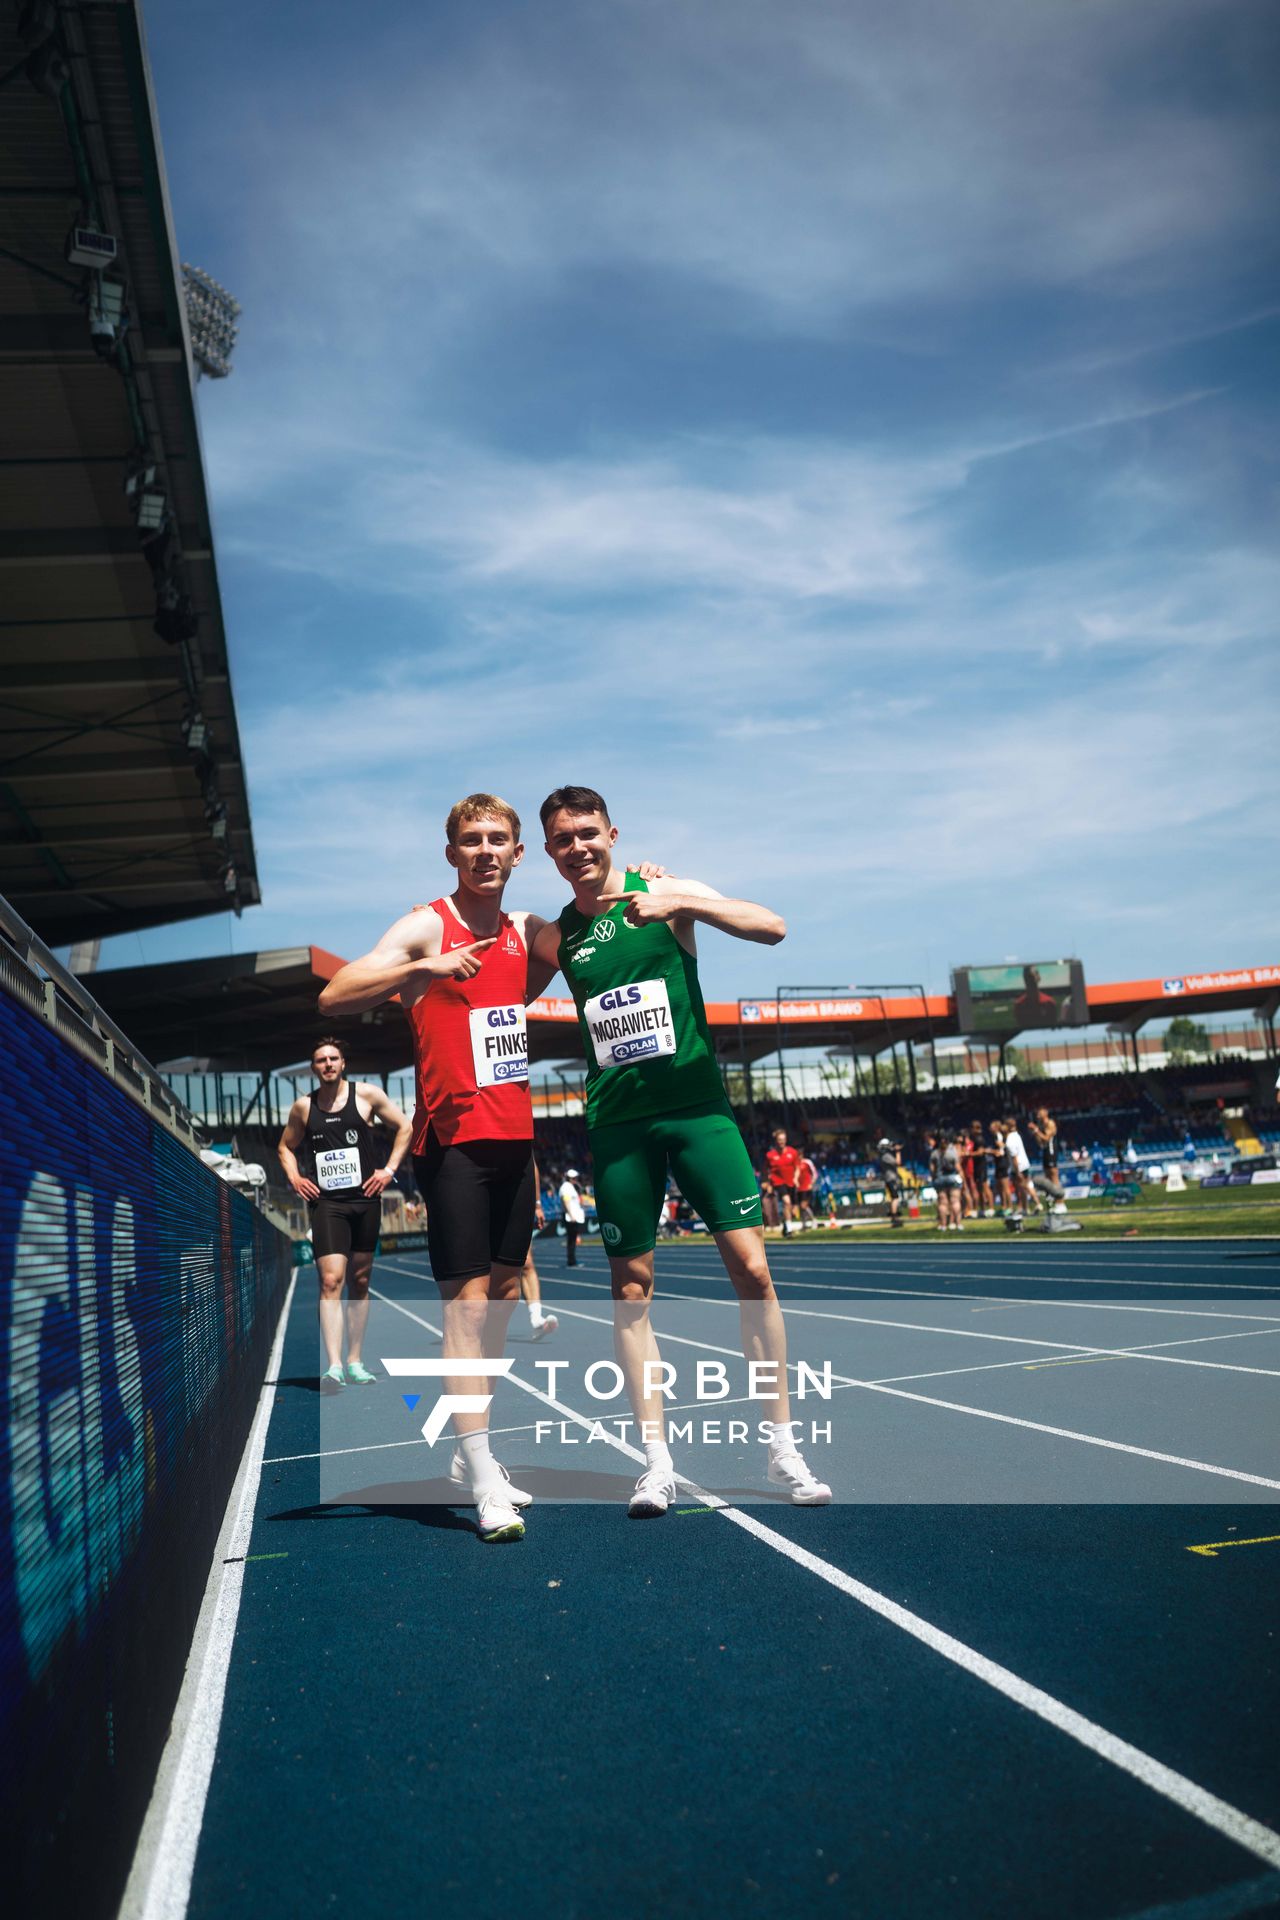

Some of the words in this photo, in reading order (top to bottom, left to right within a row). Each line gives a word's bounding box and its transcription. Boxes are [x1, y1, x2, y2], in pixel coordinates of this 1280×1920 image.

[592, 1006, 669, 1043] MORAWIETZ
[630, 1038, 656, 1052] PLAN
[320, 1163, 357, 1177] BOYSEN
